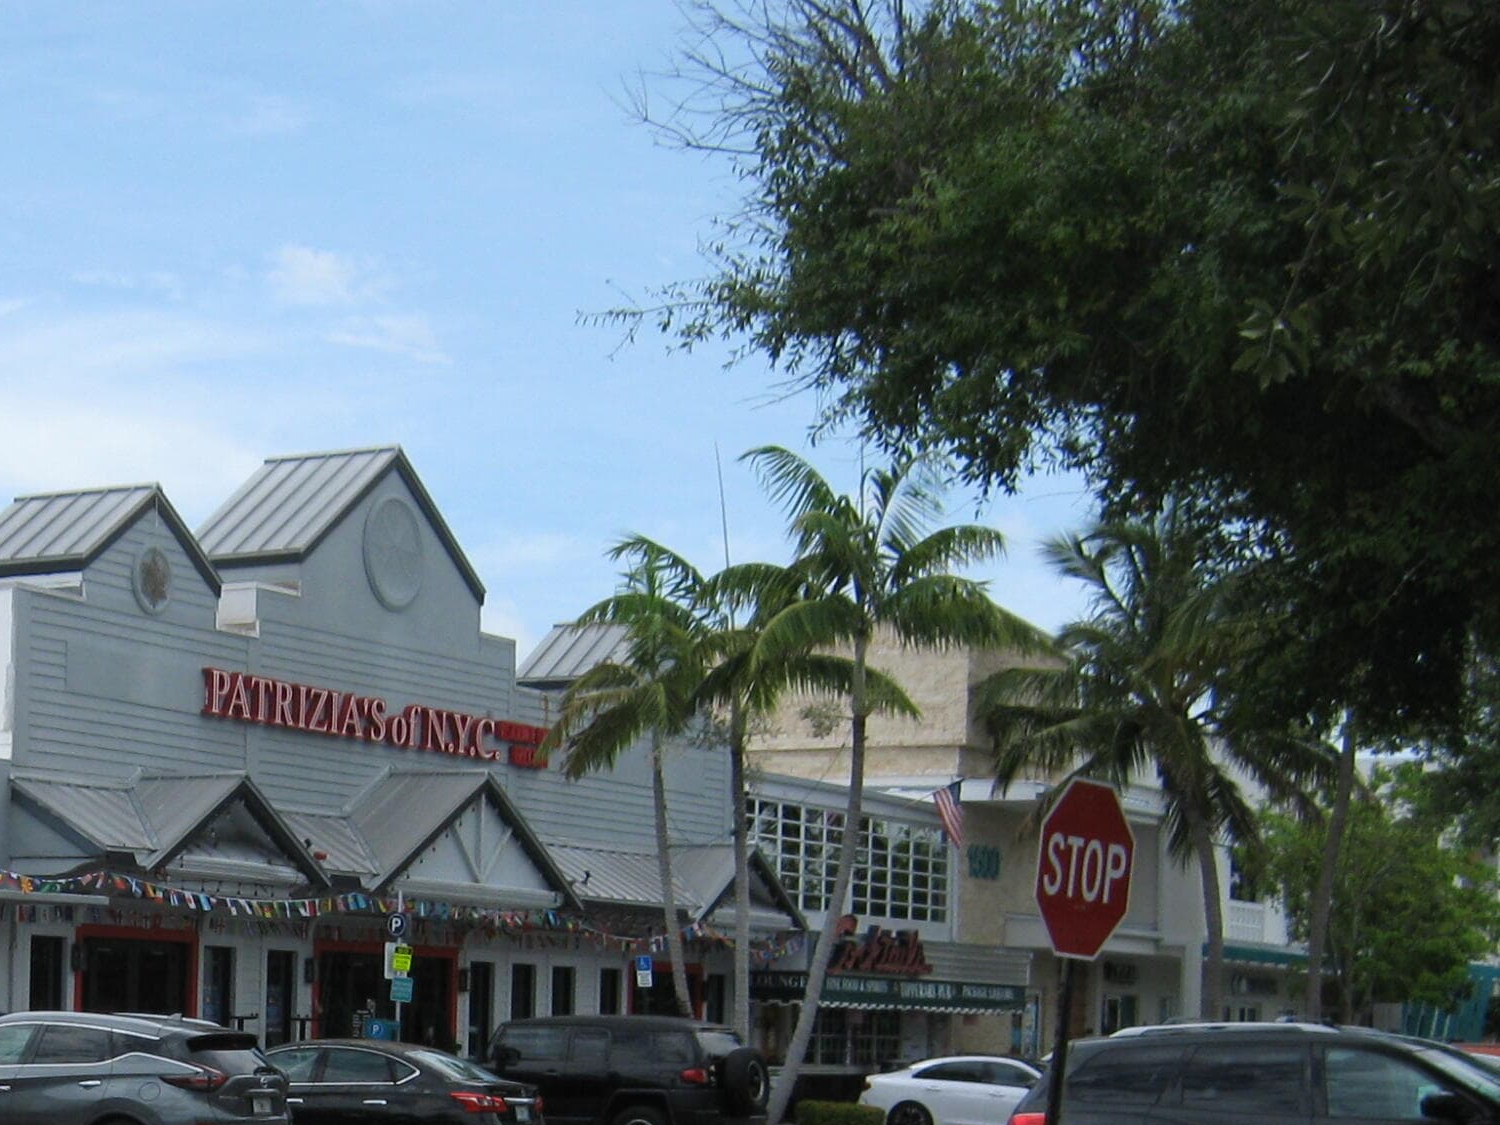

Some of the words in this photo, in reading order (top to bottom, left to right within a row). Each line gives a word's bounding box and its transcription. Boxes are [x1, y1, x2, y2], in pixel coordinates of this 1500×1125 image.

[208, 669, 387, 742] PATRIZIA'S
[391, 706, 420, 748] of
[427, 708, 501, 760] N.Y.C.
[1043, 831, 1127, 904] STOP
[392, 919, 402, 933] P
